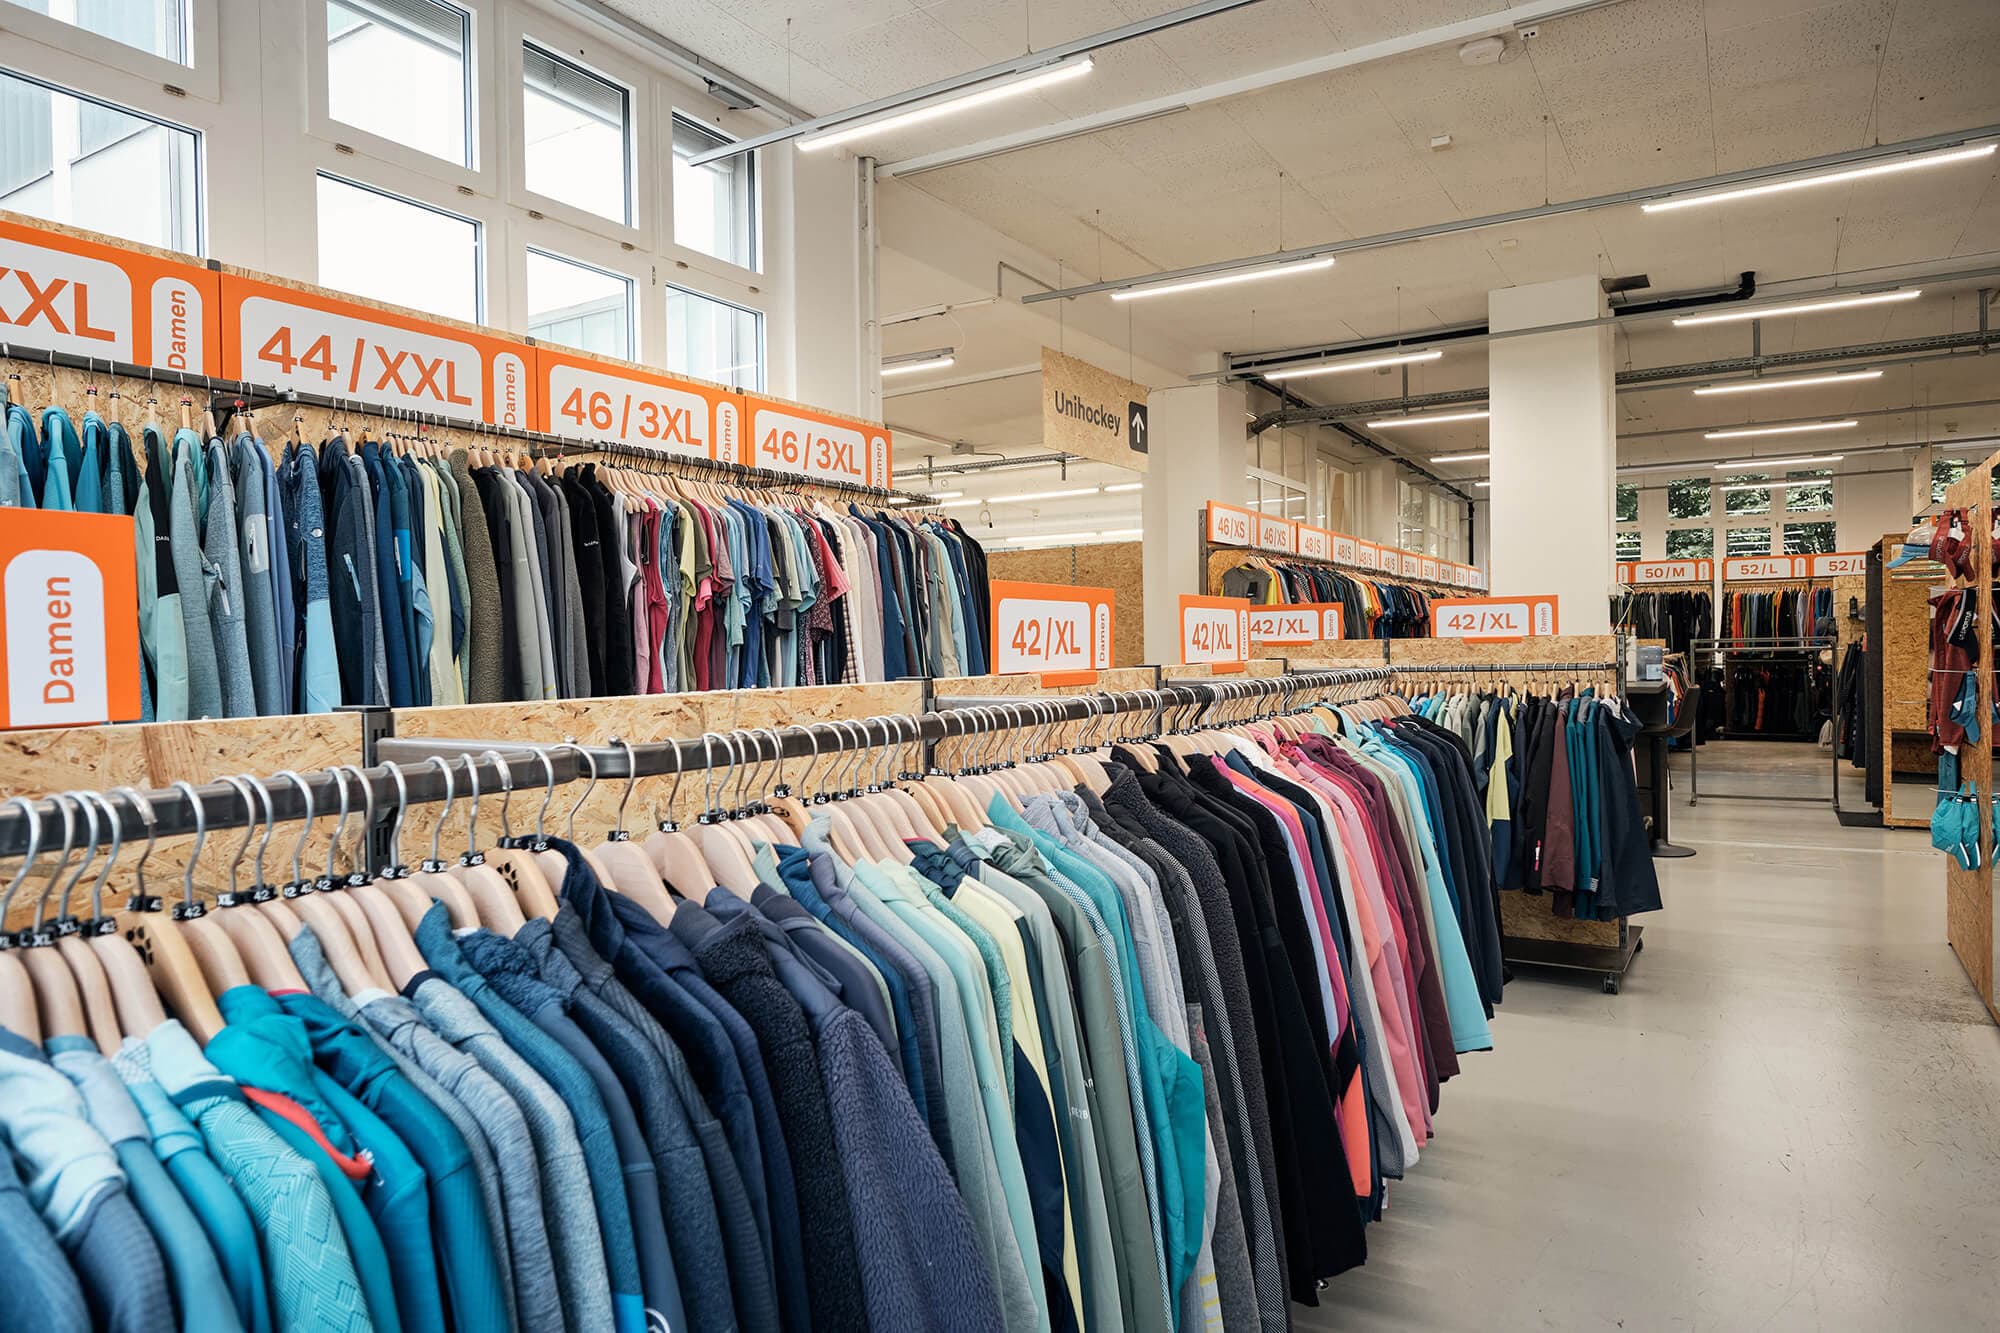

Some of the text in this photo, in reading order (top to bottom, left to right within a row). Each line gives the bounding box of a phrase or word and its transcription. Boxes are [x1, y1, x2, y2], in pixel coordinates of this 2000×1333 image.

[0, 266, 115, 342] XL
[167, 290, 186, 370] Damen
[258, 326, 473, 406] 44/XXL
[503, 362, 516, 425] Damen
[561, 387, 702, 446] 46/3XL
[1054, 390, 1121, 437] Unihockey
[722, 409, 731, 462] Damen
[762, 428, 862, 475] 46/3XL
[1217, 517, 1245, 539] 46/XS
[1645, 566, 1686, 579] 50/M
[1740, 563, 1778, 576] 52/L
[1192, 621, 1232, 654] 42/XL
[1250, 618, 1309, 637] 42/XL
[1448, 612, 1518, 632] 42/XL
[43, 576, 75, 705] Damen
[1011, 617, 1081, 661] 42/XL
[662, 823, 674, 832] XL
[253, 890, 269, 901] 42
[58, 921, 76, 935] XL
[183, 906, 201, 919] 42
[31, 933, 53, 948] XL
